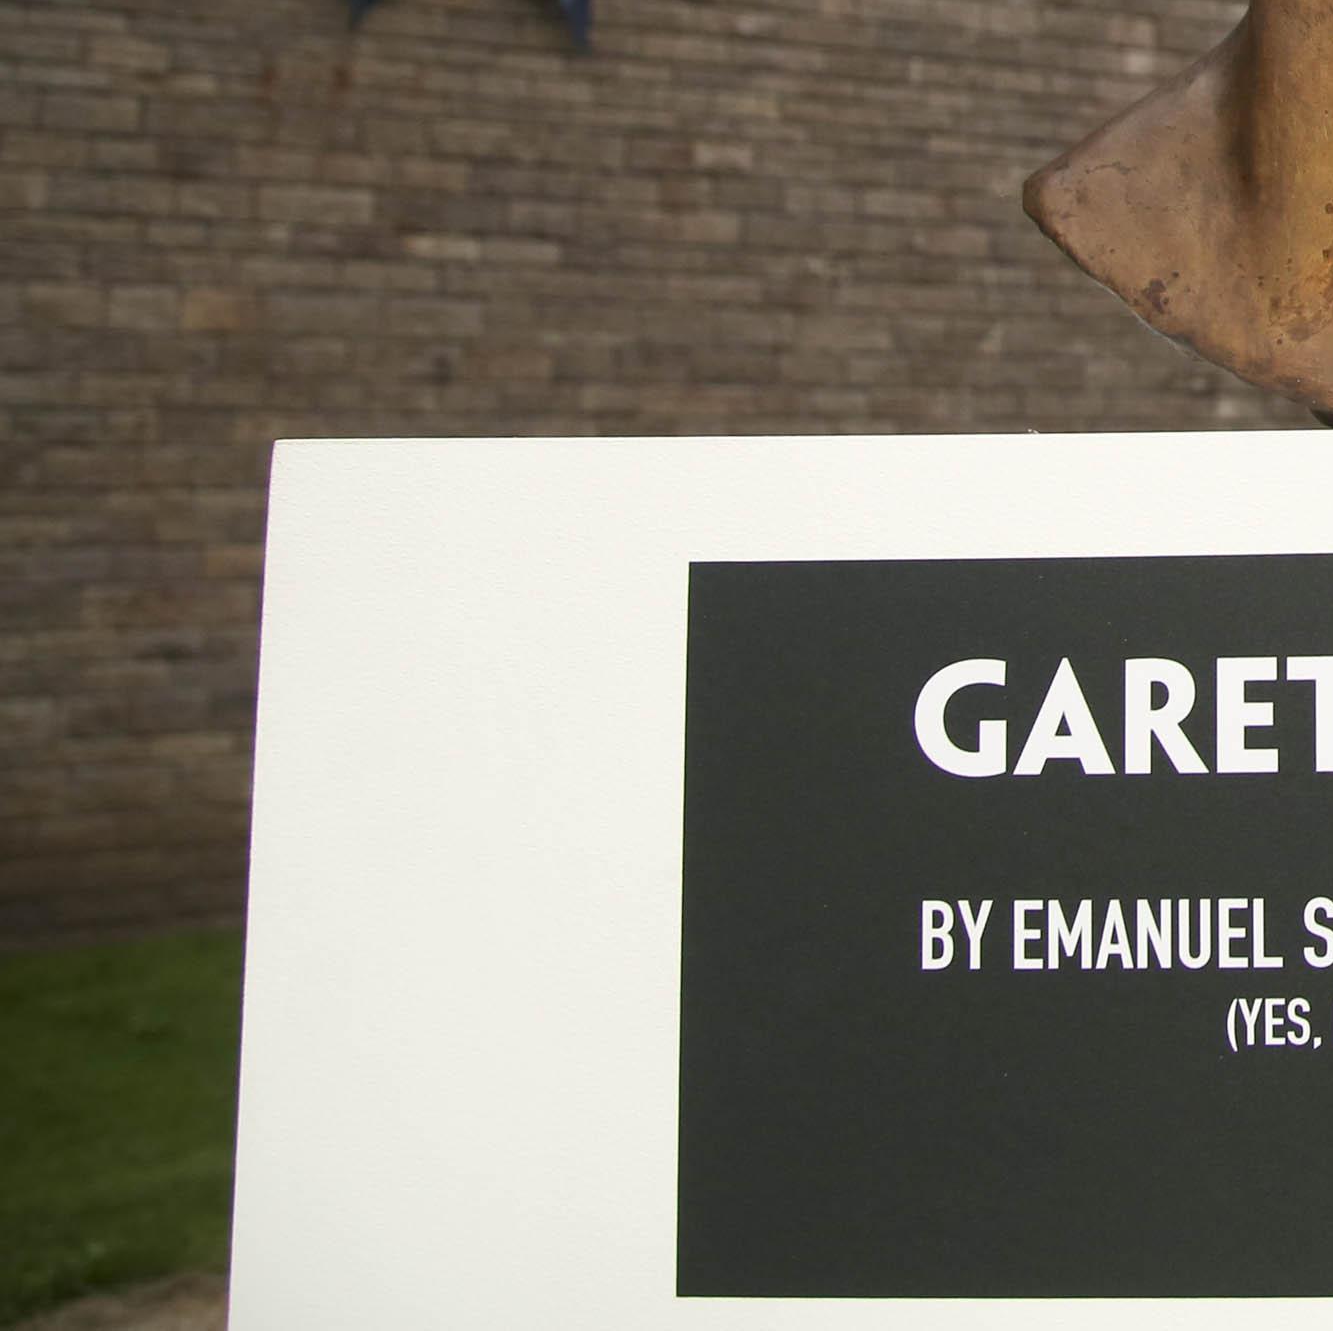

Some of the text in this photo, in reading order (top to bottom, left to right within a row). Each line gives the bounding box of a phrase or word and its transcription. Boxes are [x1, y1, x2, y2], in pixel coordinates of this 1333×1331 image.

[920, 898, 995, 971] BY
[1012, 896, 1285, 971] EMANUEL
[1225, 995, 1323, 1053] (YES,
